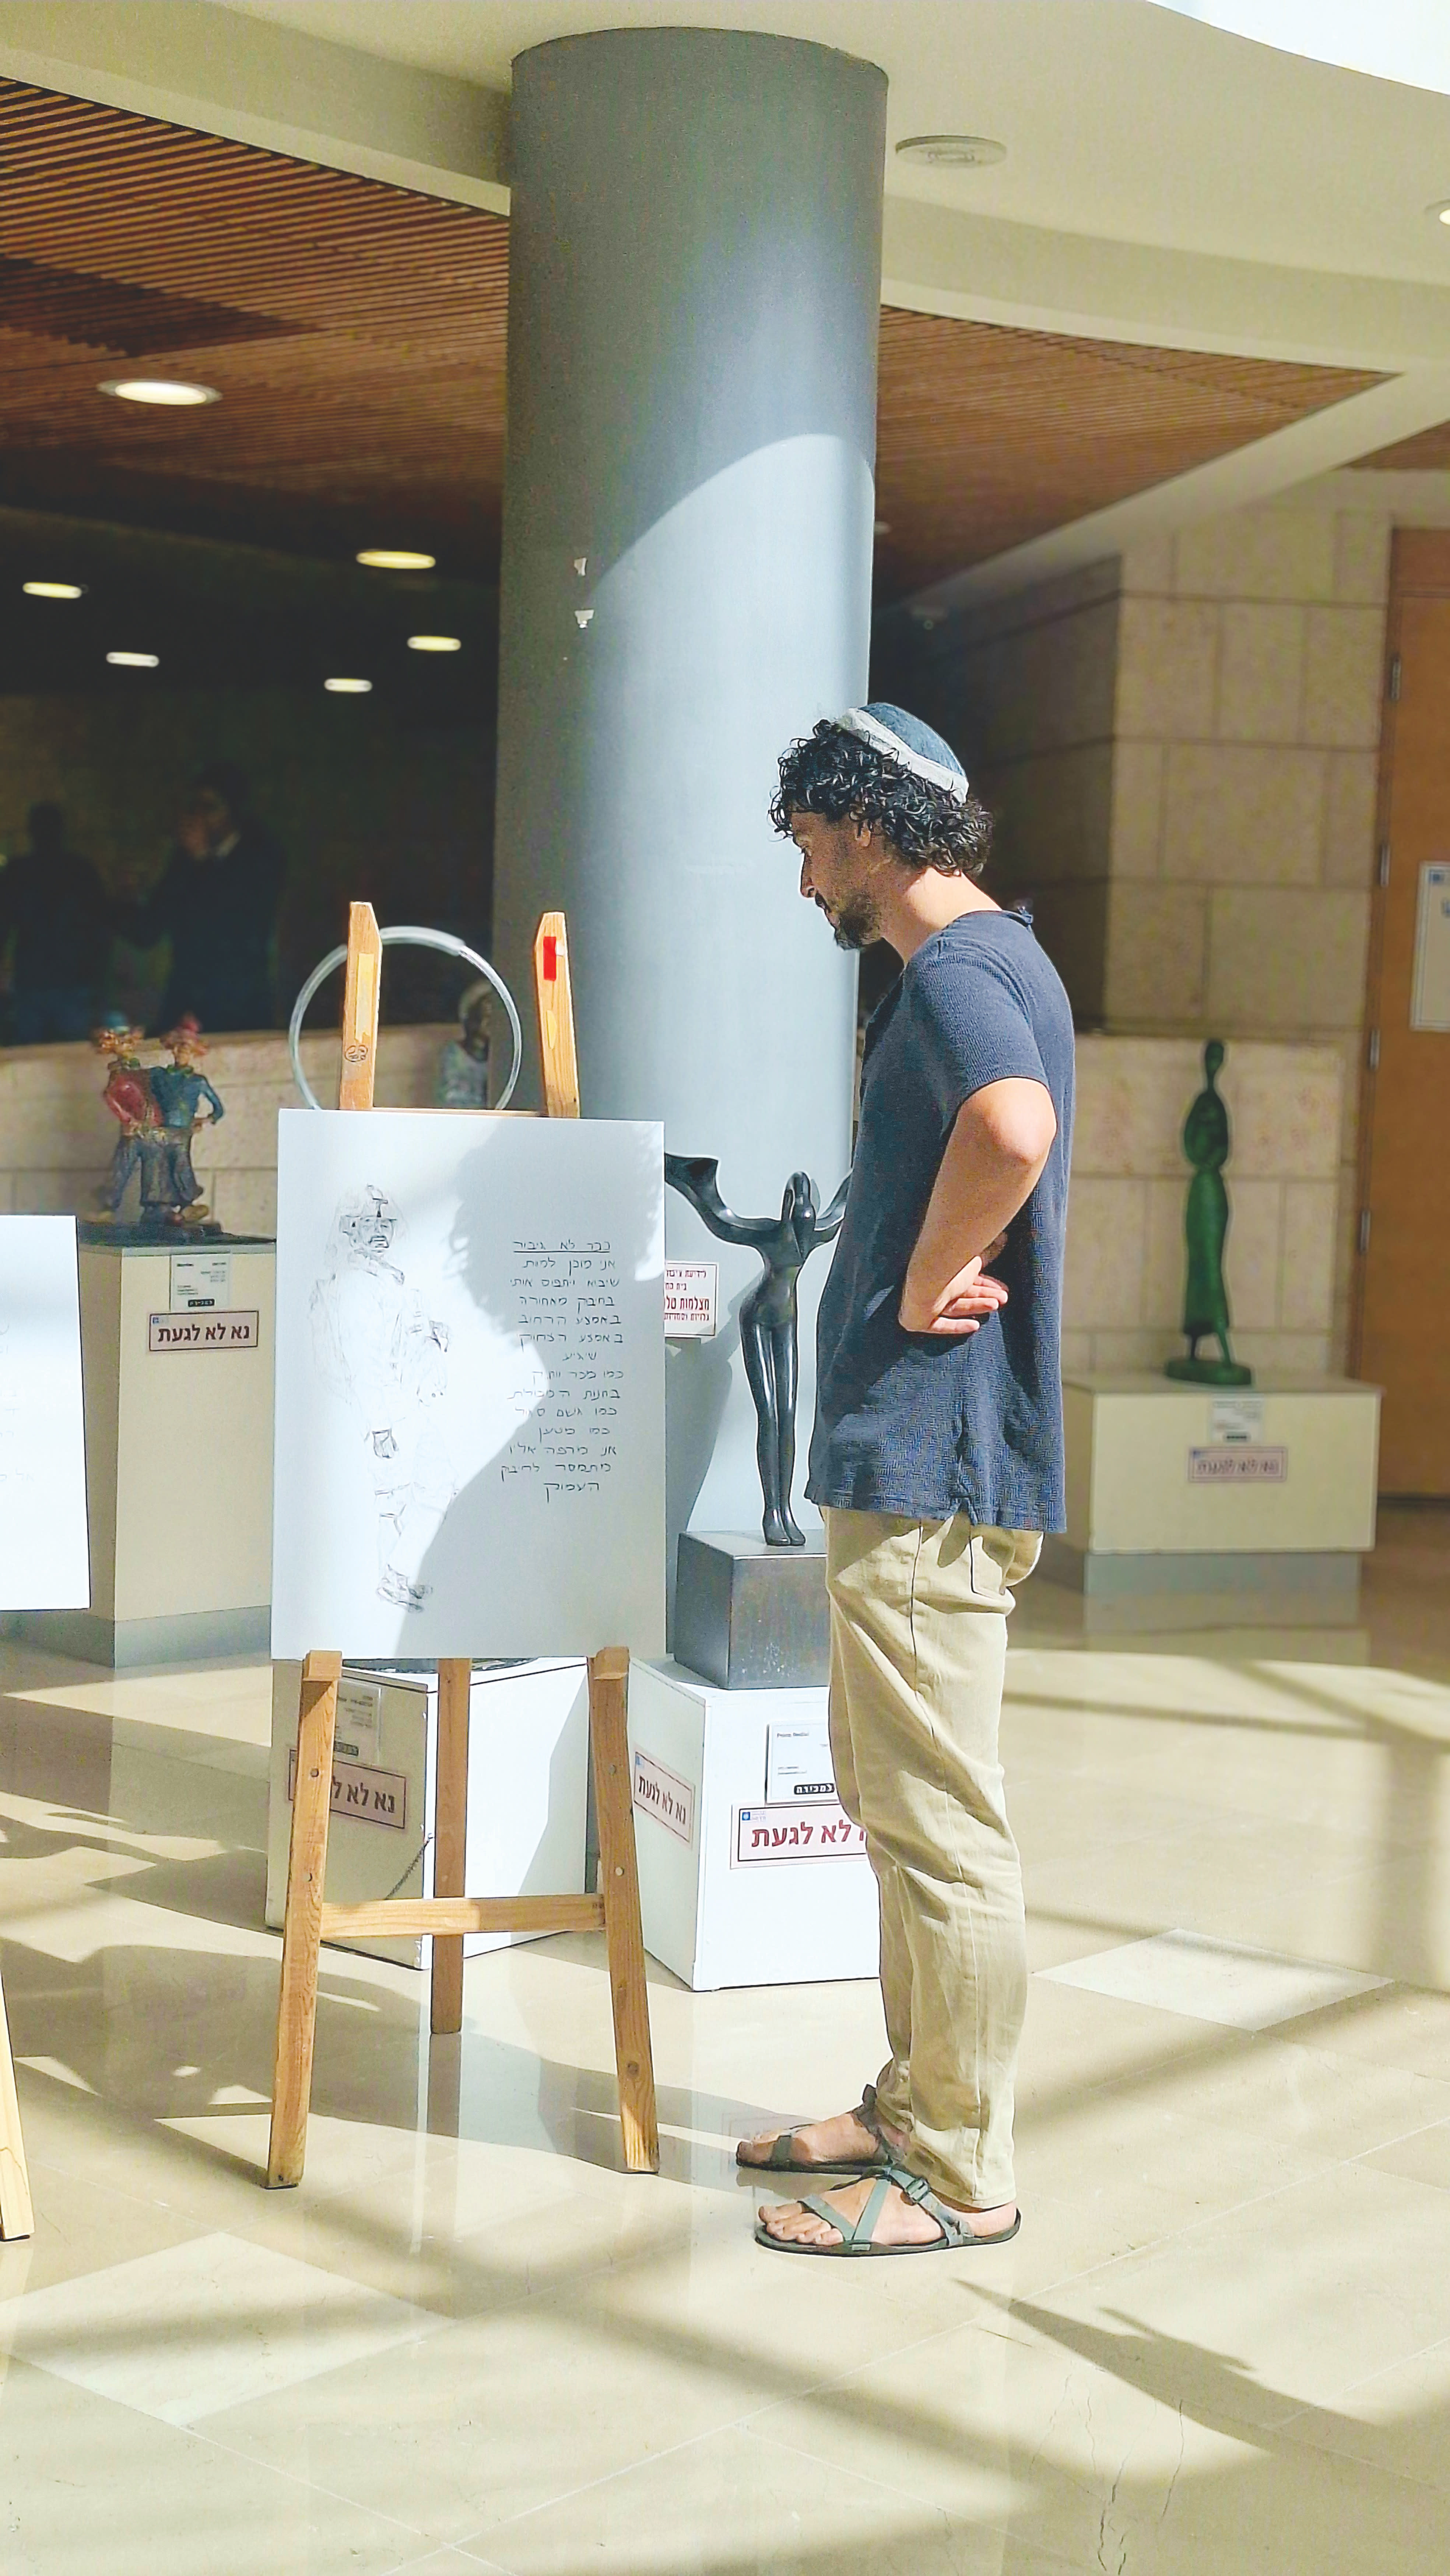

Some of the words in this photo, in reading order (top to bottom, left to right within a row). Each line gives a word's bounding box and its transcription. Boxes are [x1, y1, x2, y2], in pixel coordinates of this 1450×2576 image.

[513, 1241, 546, 1250] גיבור
[561, 1239, 575, 1250] לא
[587, 1241, 610, 1250] כבר
[523, 1257, 555, 1268] למות
[569, 1260, 591, 1276] מוכן
[600, 1260, 615, 1270] אני
[510, 1278, 533, 1287] אותי
[542, 1279, 575, 1287] ויתפוס
[519, 1296, 567, 1306] מאחורה
[577, 1296, 615, 1314] בחיבוק
[667, 1295, 676, 1310] טל
[519, 1315, 566, 1325] הרחוב
[158, 1324, 201, 1342] לגעת
[206, 1323, 226, 1340] לא
[231, 1325, 250, 1339] נא
[519, 1333, 566, 1352] הצחוק
[562, 1352, 597, 1361] שיגיע
[532, 1370, 561, 1384] וותק
[568, 1370, 596, 1379] מכר
[604, 1370, 624, 1379] כמו
[507, 1388, 570, 1399] המכולת
[583, 1389, 621, 1401] בחנות
[557, 1408, 582, 1417] גשם
[595, 1408, 617, 1416] כמו
[539, 1427, 575, 1443] מטען
[509, 1442, 536, 1454] אליו
[601, 1446, 617, 1457] אני
[501, 1462, 540, 1482] לחיבוק
[543, 1482, 600, 1503] העמוק
[347, 1782, 369, 1806] לא
[639, 1775, 660, 1805] לגעת
[796, 1784, 833, 1794] למכירה
[375, 1791, 395, 1813] נא
[662, 1791, 673, 1815] לא
[676, 1802, 686, 1824] נא
[751, 1822, 814, 1847] לגעת
[821, 1820, 852, 1843] לא
